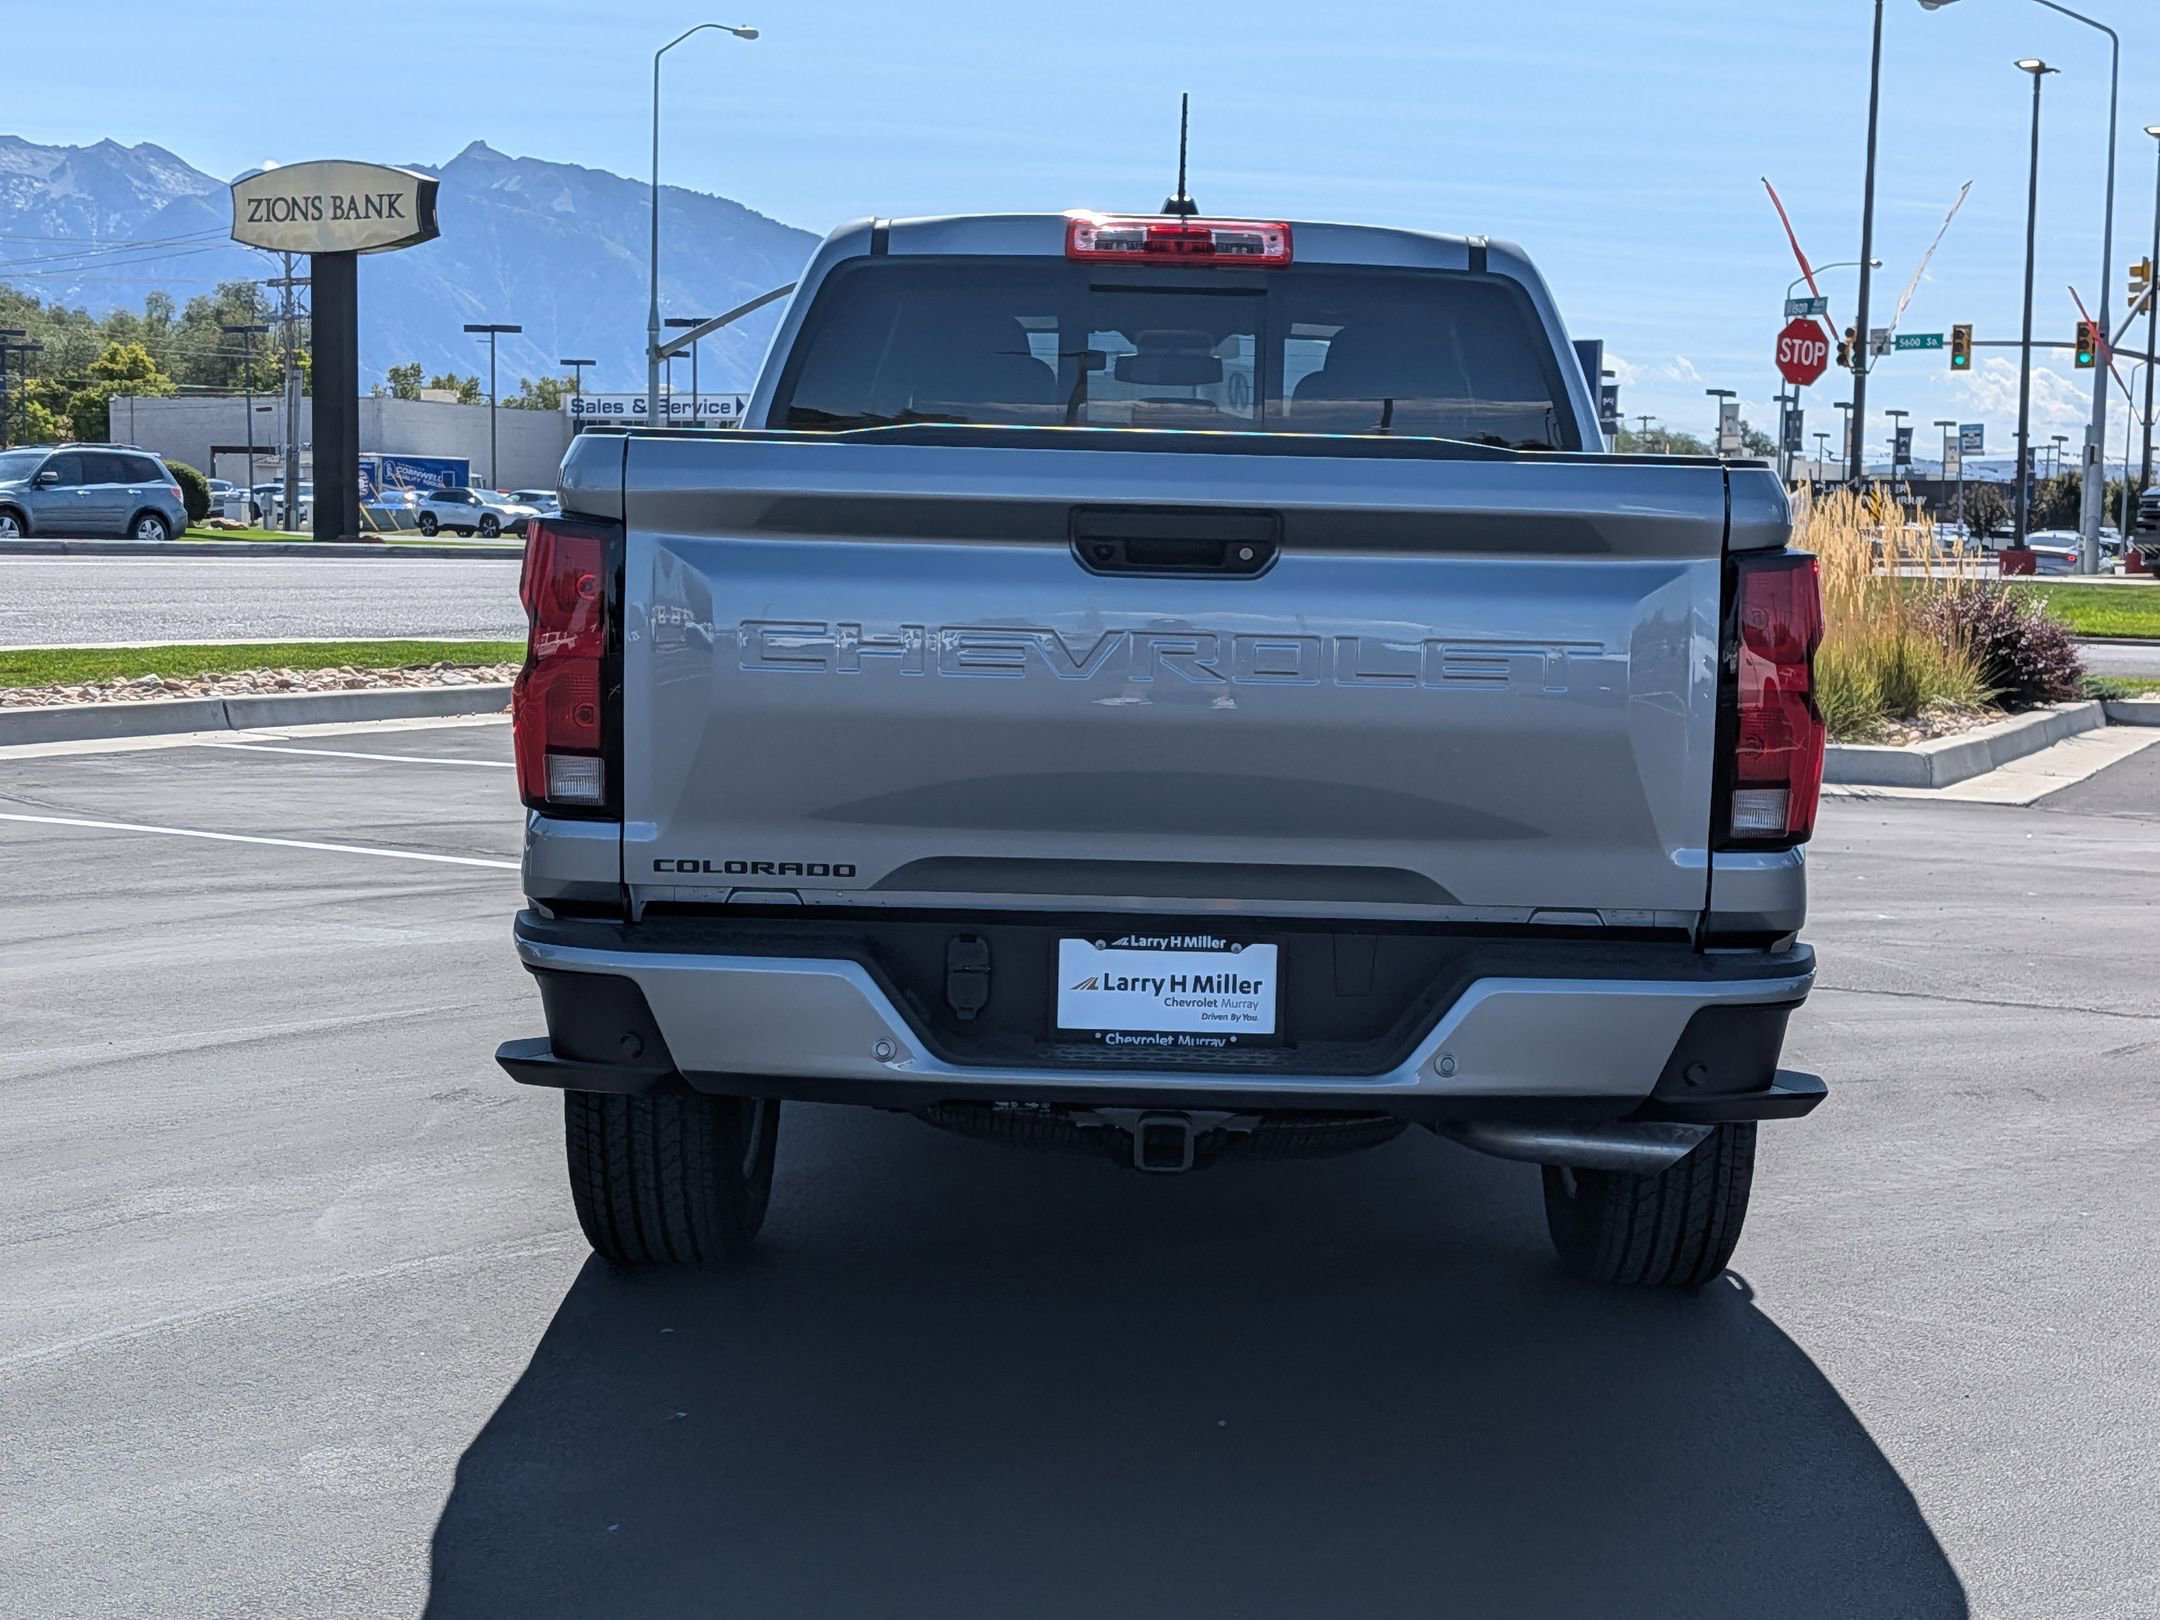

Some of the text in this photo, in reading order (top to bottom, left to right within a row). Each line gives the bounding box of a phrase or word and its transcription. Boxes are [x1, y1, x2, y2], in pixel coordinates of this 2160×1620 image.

[248, 193, 405, 222] ZIONS BANK
[1779, 337, 1826, 367] STOP
[571, 398, 731, 414] Sales & Service
[738, 618, 1605, 692] CHEVROLET
[653, 859, 857, 877] COLORADO
[1131, 935, 1226, 950] Larry H Miller
[1104, 973, 1263, 997] Larry H Miller
[1164, 997, 1259, 1010] Chevrolet Murray
[1201, 1012, 1228, 1021] Driven
[1230, 1013, 1241, 1022] By
[1105, 1032, 1226, 1048] Chevrolet Murray
